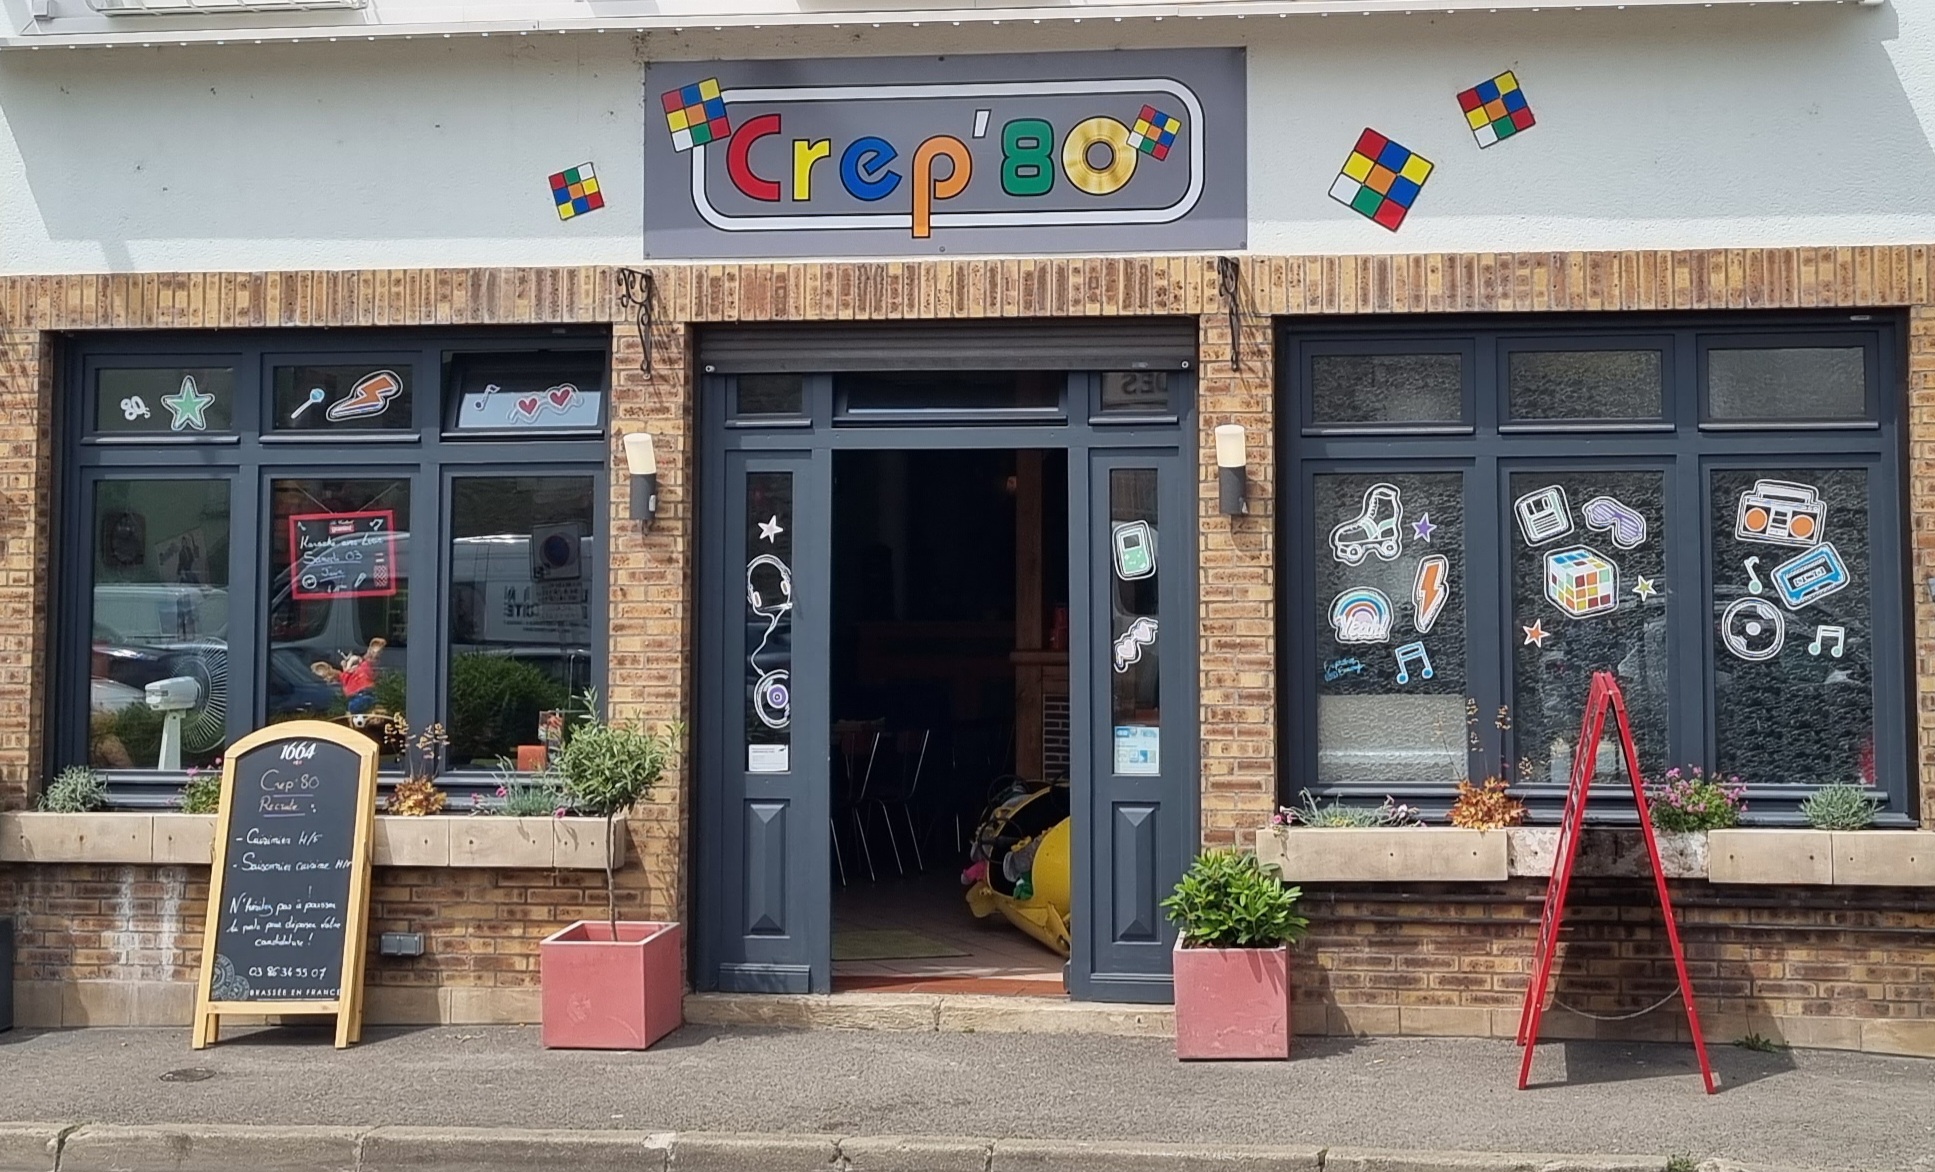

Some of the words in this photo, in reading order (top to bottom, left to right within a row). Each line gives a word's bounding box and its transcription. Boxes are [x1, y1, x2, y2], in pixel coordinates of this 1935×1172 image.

[345, 550, 363, 561] 03
[280, 741, 317, 760] 1664
[246, 828, 291, 845] Cuisinier
[295, 860, 331, 872] cuisine
[275, 902, 292, 916] pas
[248, 966, 263, 977] 03
[310, 967, 327, 981] 07
[291, 988, 302, 996] EN
